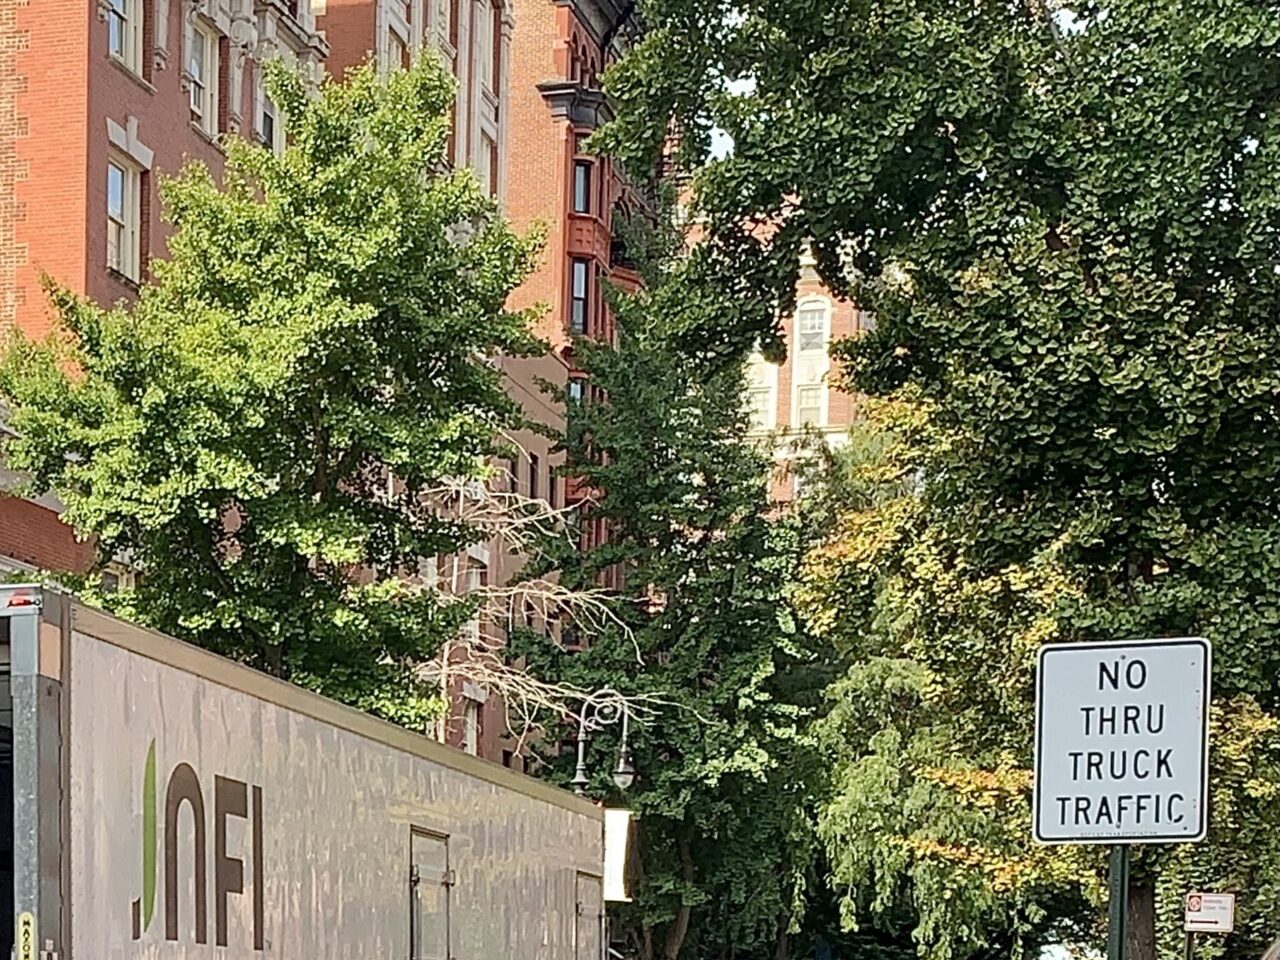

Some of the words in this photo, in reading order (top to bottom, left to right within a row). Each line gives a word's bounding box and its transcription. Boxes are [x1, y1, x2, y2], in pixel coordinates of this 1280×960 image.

[1098, 659, 1147, 690] NO
[1080, 704, 1164, 735] THRU
[1068, 749, 1173, 781] TRUCK
[1056, 793, 1184, 825] TRAFFIC
